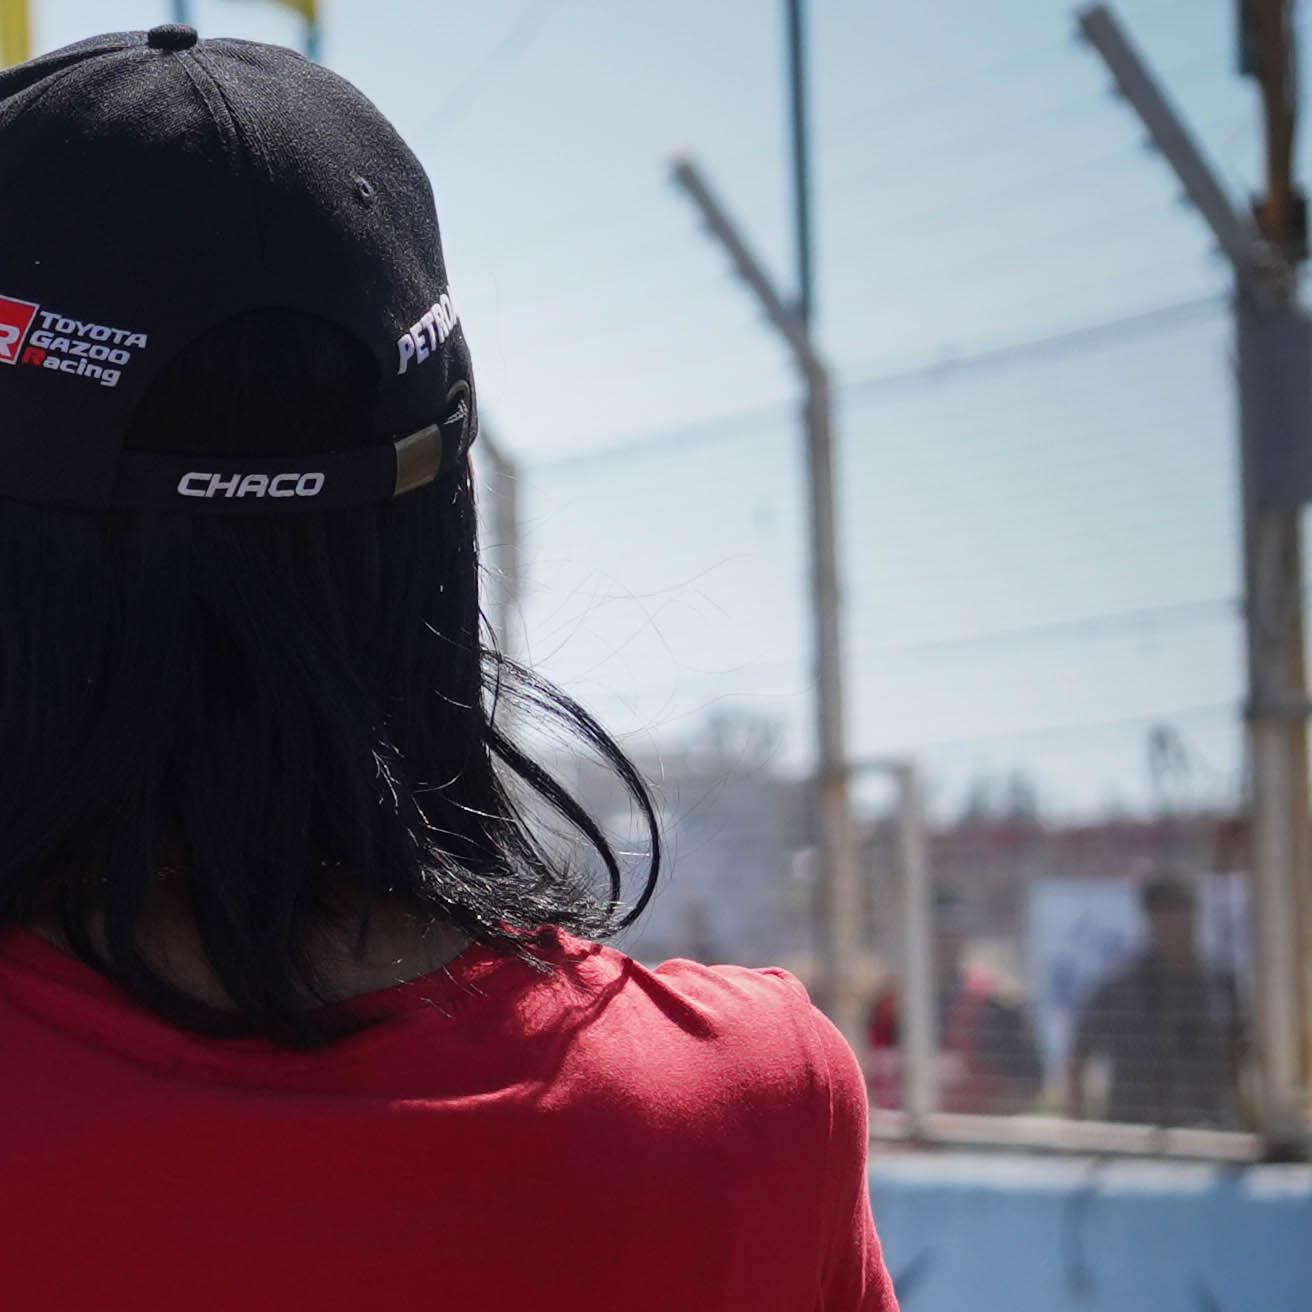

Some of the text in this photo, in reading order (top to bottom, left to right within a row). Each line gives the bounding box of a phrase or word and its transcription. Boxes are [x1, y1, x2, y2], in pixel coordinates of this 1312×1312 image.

[29, 329, 131, 366] GAZOO
[40, 310, 148, 349] TOYOTA
[397, 285, 458, 376] PETRO
[21, 347, 121, 388] Racing
[177, 471, 326, 498] CHACO
